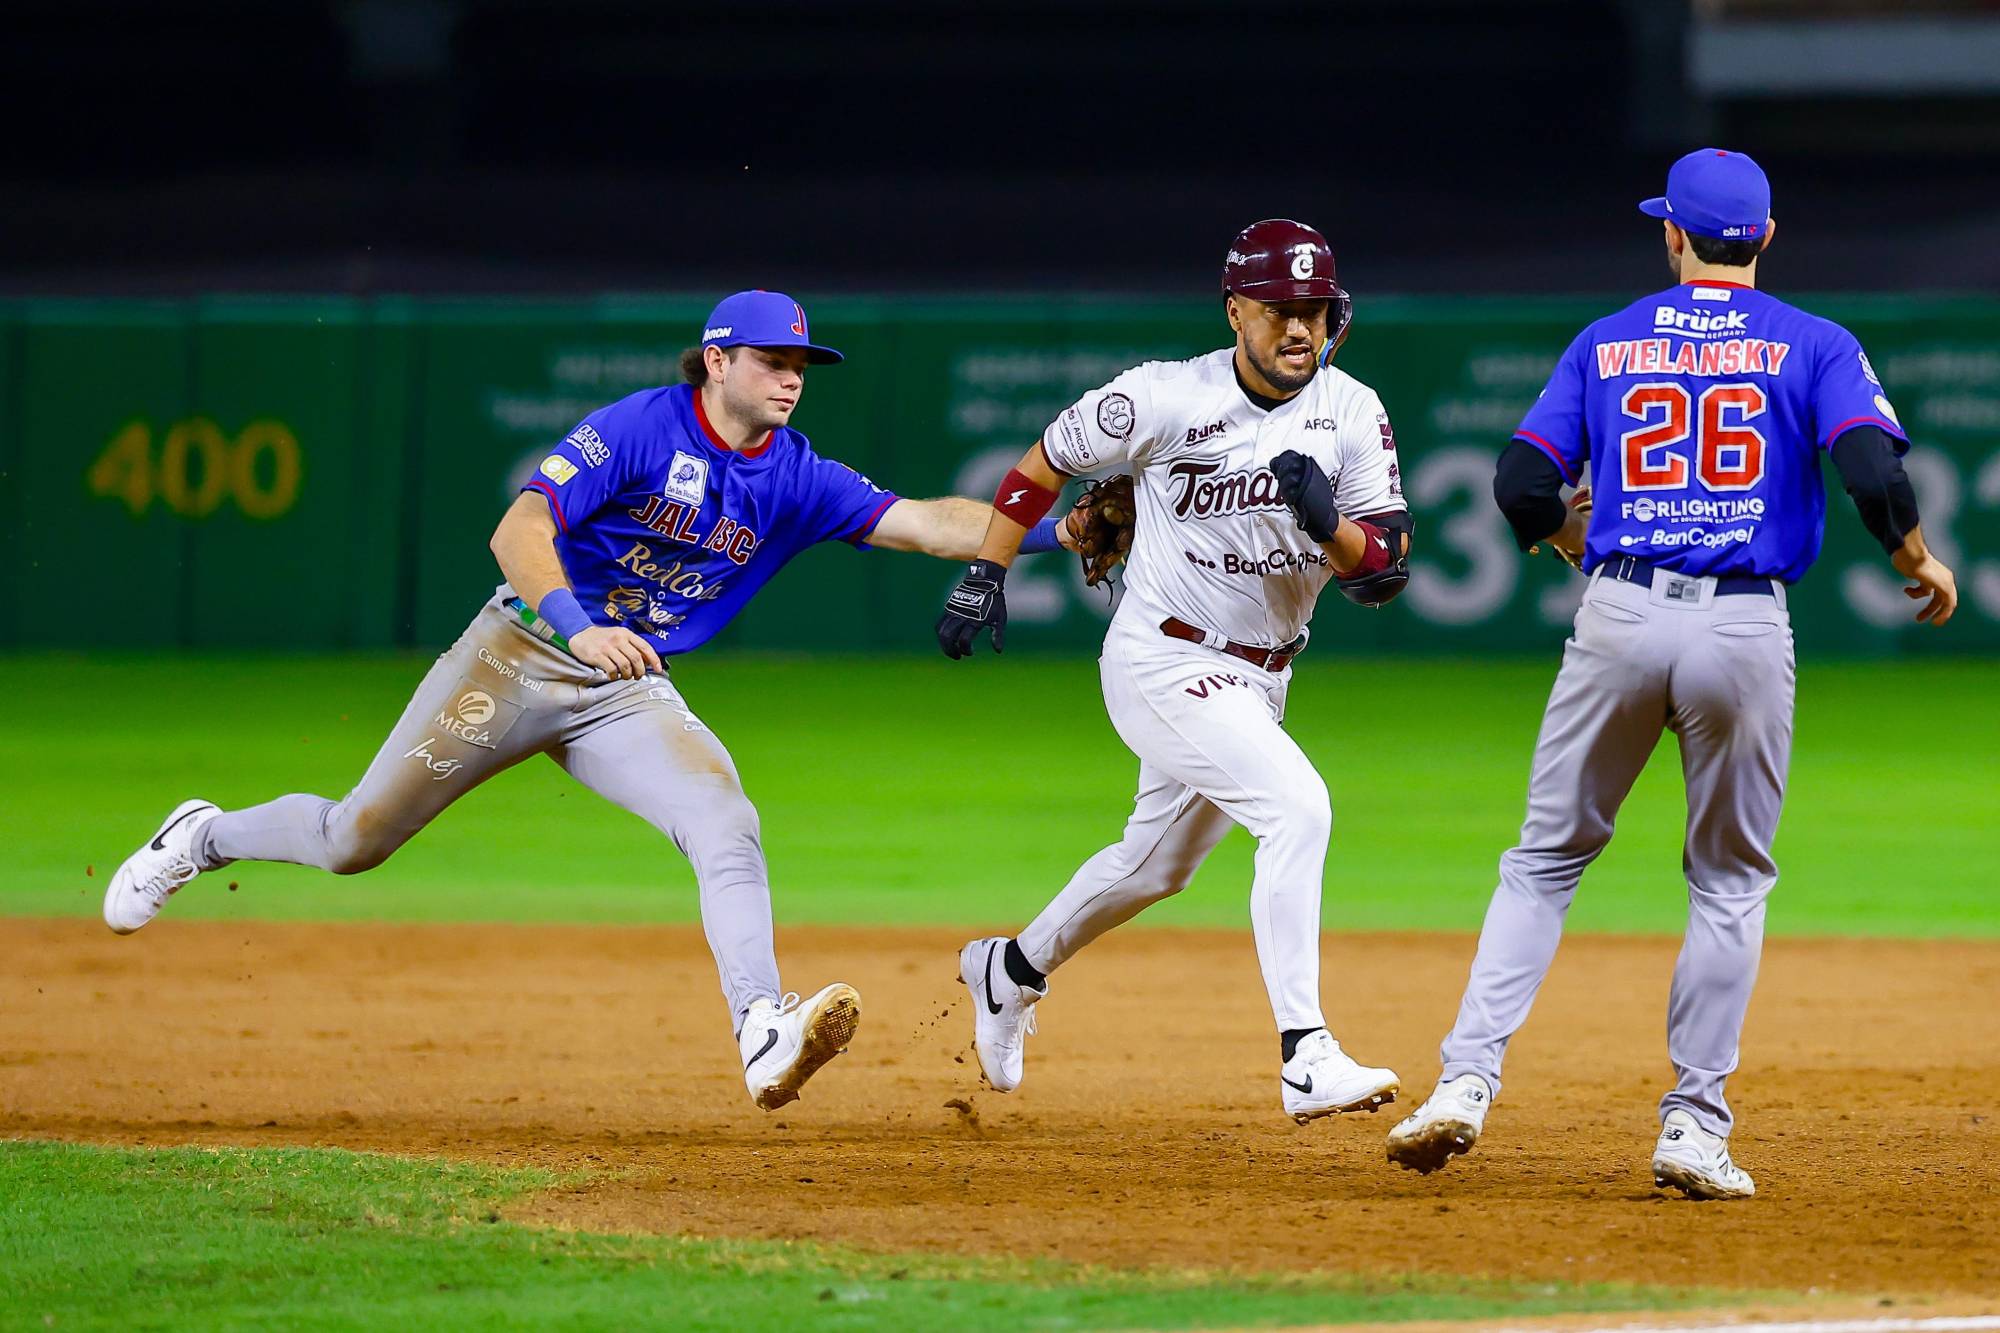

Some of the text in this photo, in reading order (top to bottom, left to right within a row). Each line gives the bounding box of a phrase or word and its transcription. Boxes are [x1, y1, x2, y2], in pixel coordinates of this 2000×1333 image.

[1654, 305, 1750, 333] Brück
[702, 327, 732, 343] AKRON
[1596, 338, 1791, 379] WIELANSKY
[1073, 426, 1086, 452] ARCO
[1621, 382, 1767, 492] 26
[87, 418, 302, 519] 400
[628, 495, 764, 565] JALISC
[1650, 526, 1754, 549] BanCoppel
[1223, 548, 1329, 577] BanCoppe
[478, 647, 545, 693] Campo Azul
[435, 711, 490, 742] MEGA
